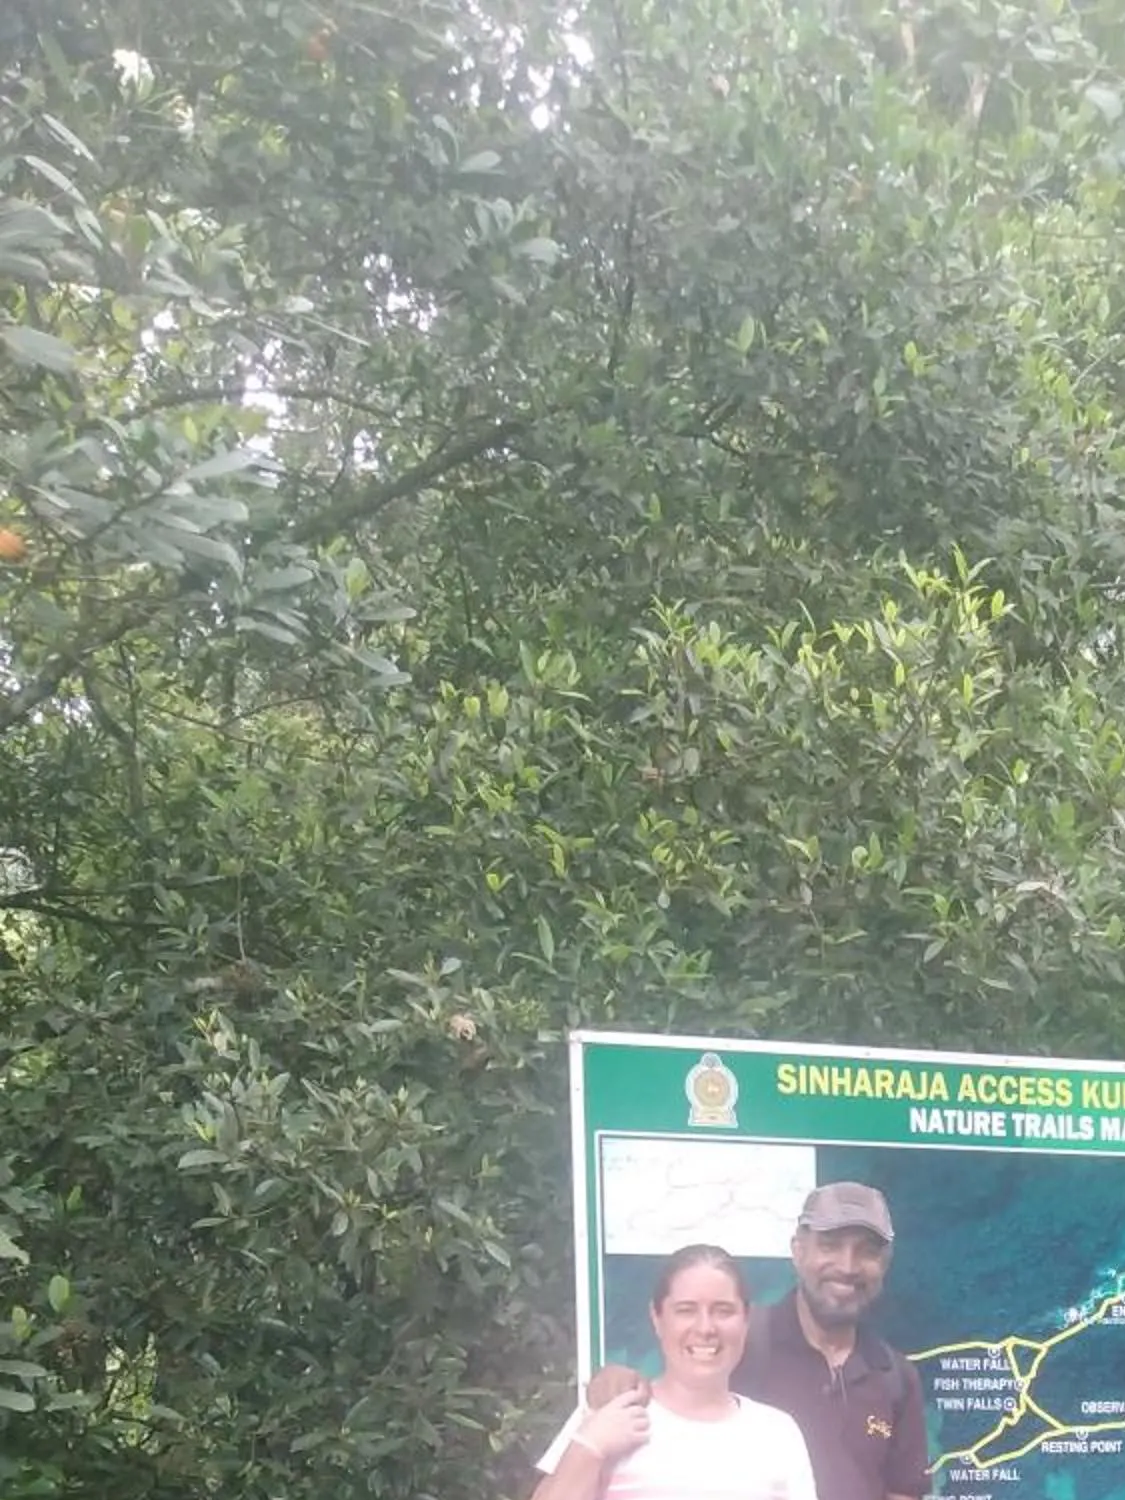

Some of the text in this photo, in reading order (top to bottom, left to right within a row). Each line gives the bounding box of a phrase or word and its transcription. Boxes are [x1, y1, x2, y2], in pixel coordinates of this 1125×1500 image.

[777, 1063, 949, 1102] SINHARAJA
[957, 1073, 1073, 1108] ACCESS
[909, 1107, 1007, 1138] NATURE
[1011, 1112, 1096, 1141] TRAILS
[940, 1358, 1012, 1371] WATER FALL
[934, 1378, 1015, 1391] FISH THERAPY
[936, 1397, 1002, 1411] TWIN FALLS
[1041, 1440, 1123, 1453] RESTING POINT
[950, 1468, 1021, 1482] WATER FALL
